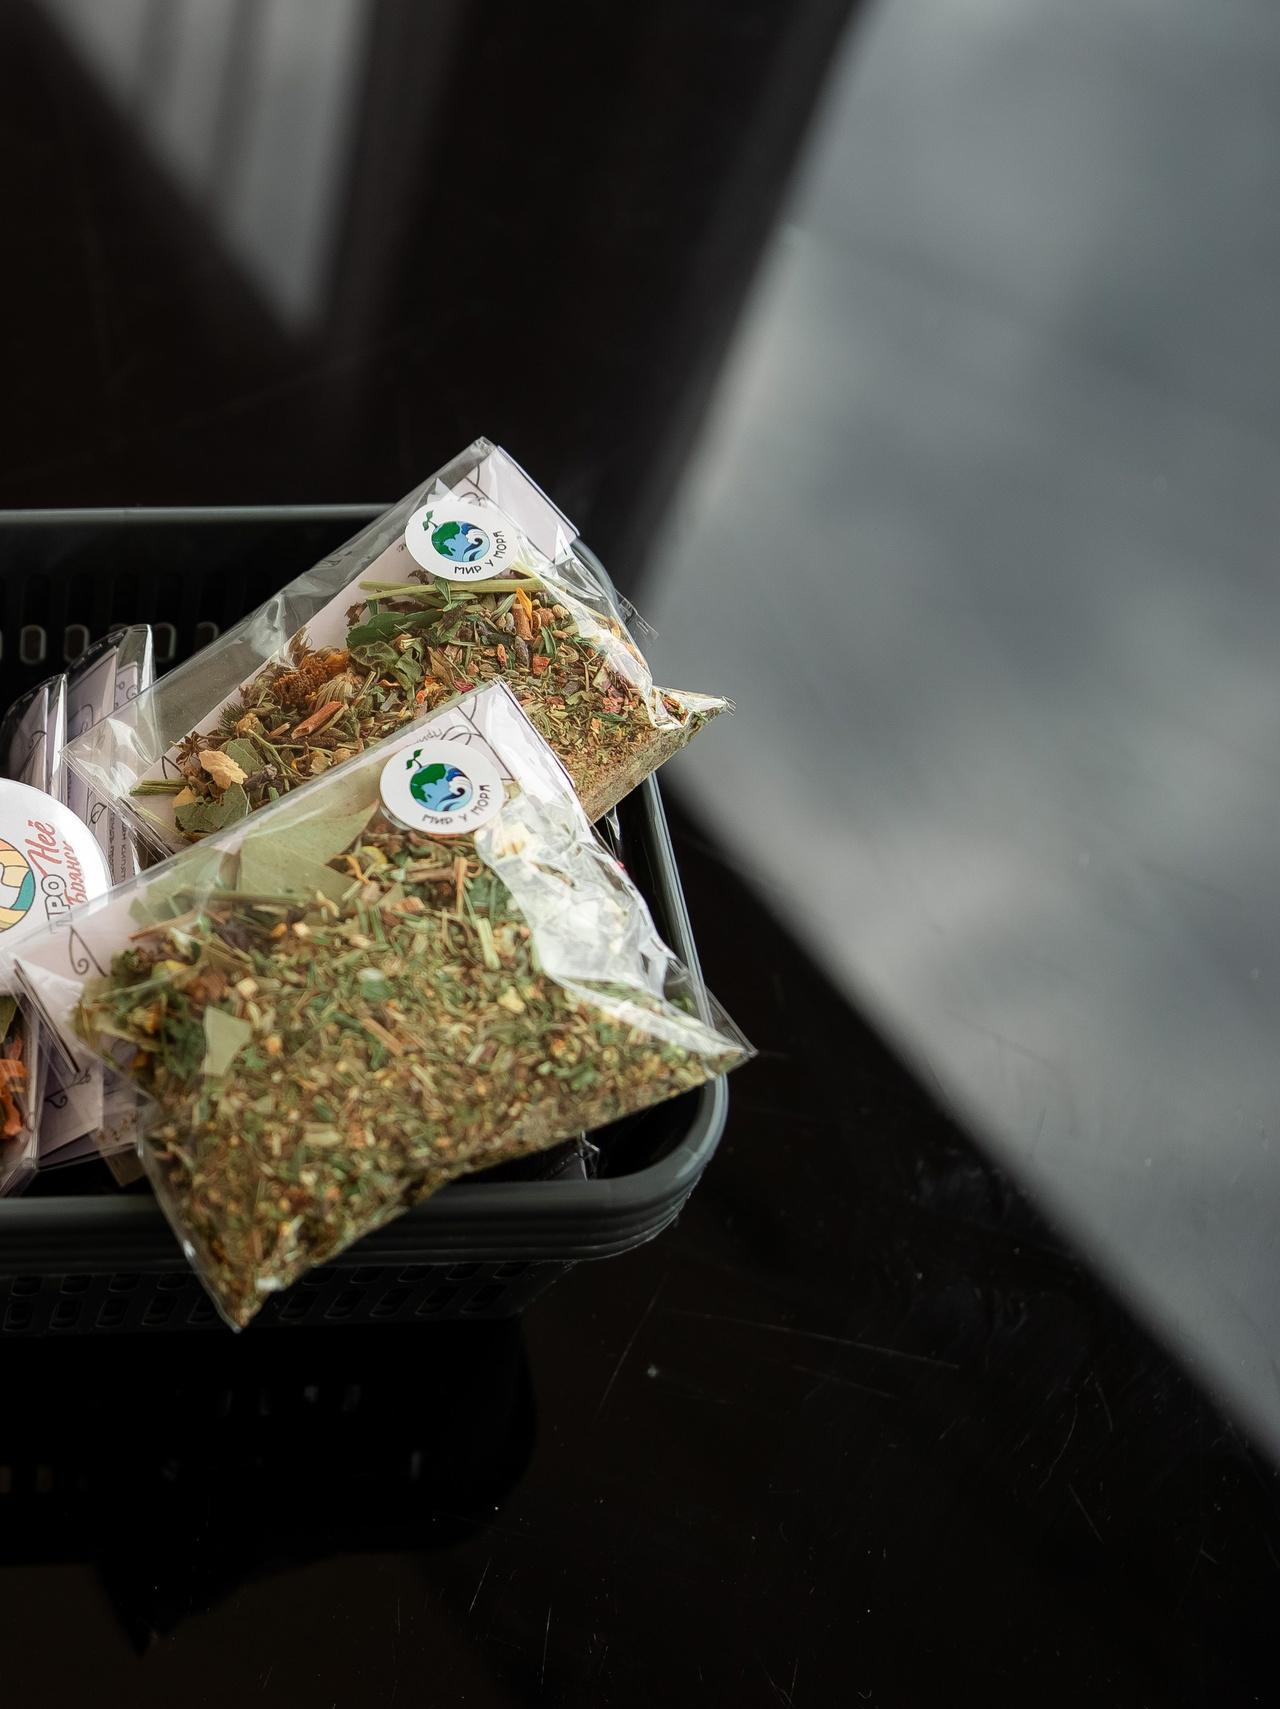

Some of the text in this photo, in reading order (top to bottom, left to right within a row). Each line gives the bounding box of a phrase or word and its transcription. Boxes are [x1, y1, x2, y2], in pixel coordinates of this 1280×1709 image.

[454, 530, 507, 575] МИР У МОРЯ
[421, 784, 491, 825] МИР У МОРЯ
[40, 874, 74, 935] ПРО
